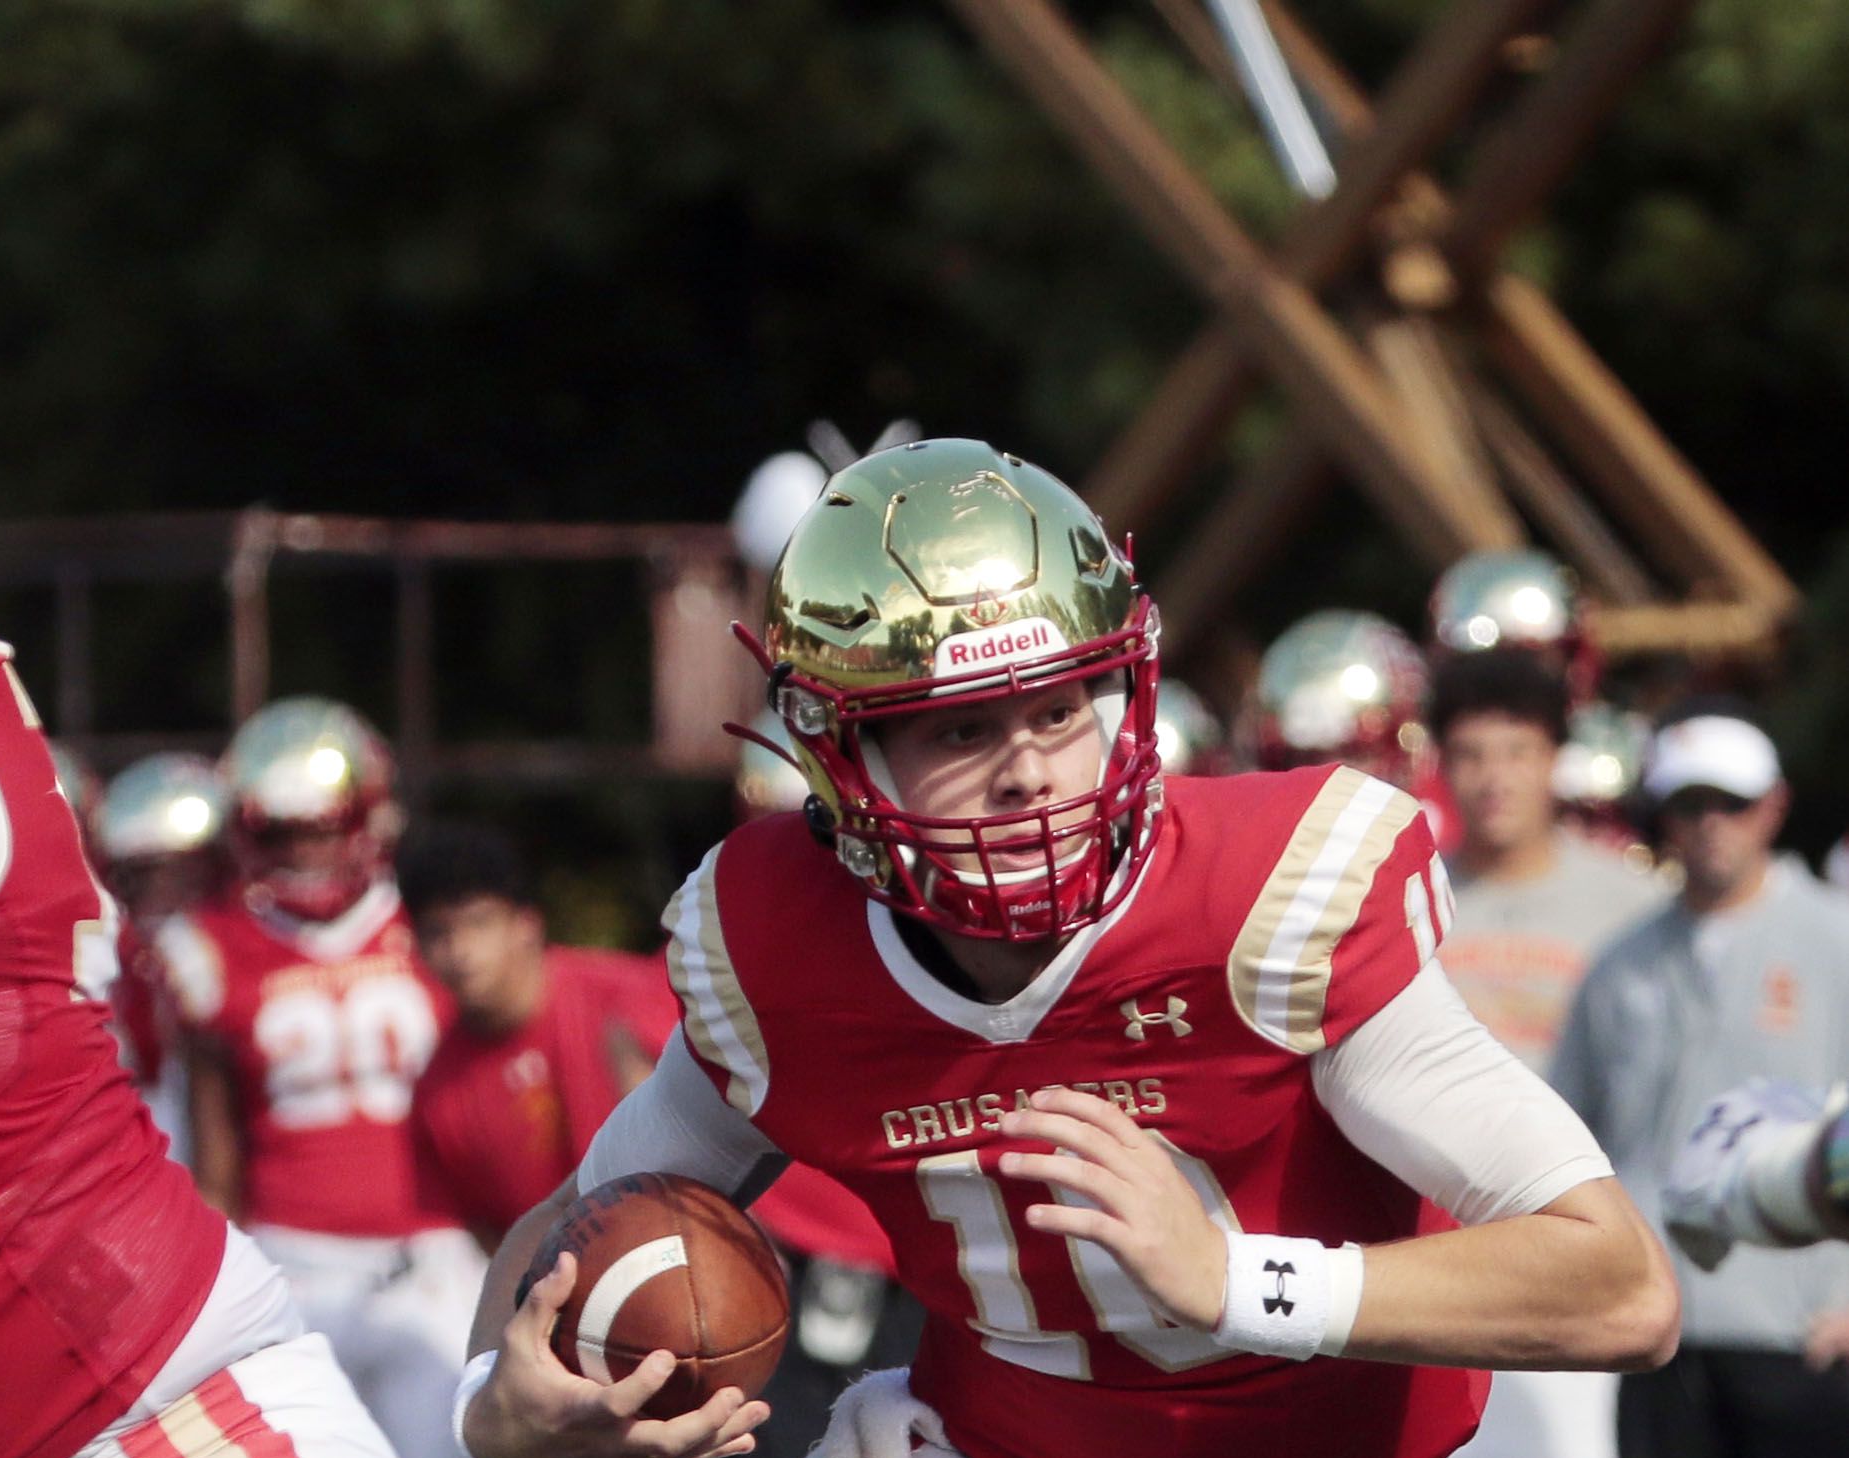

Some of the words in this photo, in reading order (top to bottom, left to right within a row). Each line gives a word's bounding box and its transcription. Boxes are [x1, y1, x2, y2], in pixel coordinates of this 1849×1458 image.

[949, 626, 1049, 665] Riddell
[1008, 900, 1052, 916] Ridde
[252, 972, 439, 1130] 20
[881, 1078, 1167, 1149] CRUSARS
